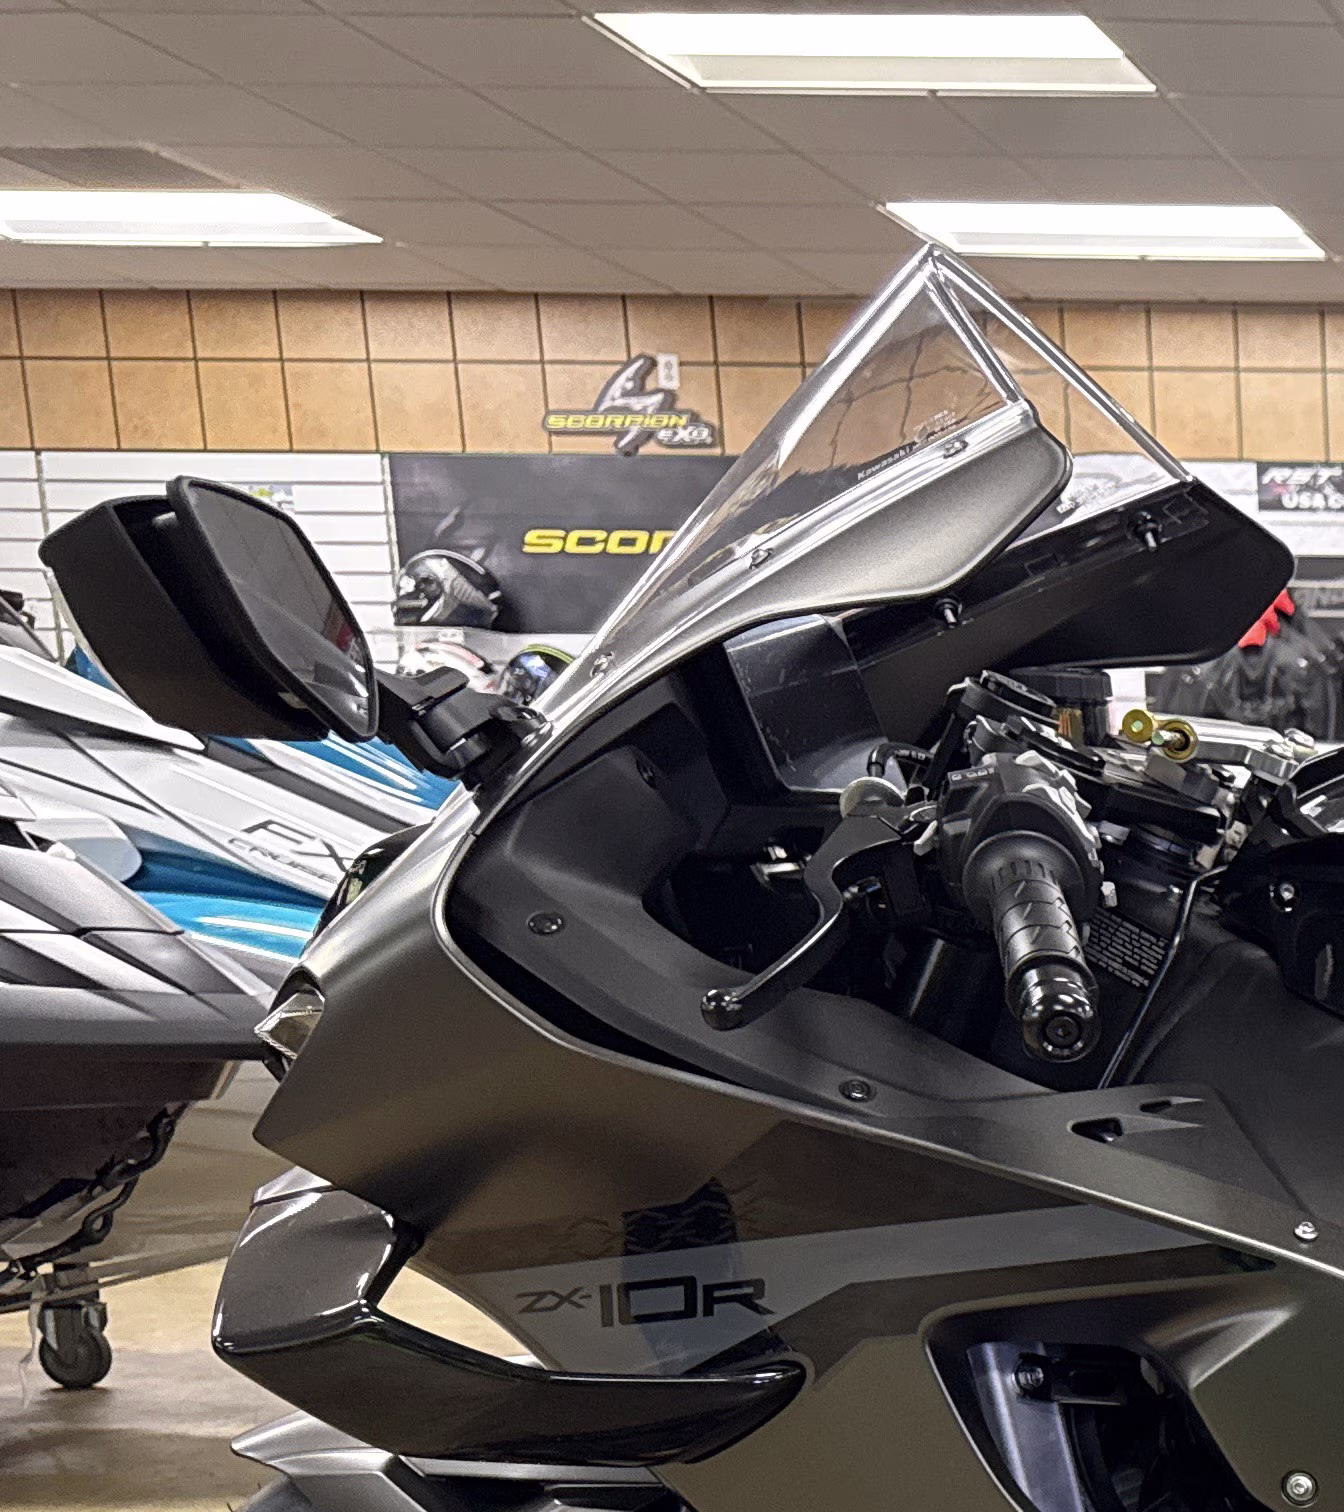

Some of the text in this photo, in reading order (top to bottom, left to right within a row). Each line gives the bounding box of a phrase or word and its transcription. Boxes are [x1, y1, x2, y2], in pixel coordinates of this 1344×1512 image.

[547, 413, 690, 430] SCORPION
[857, 444, 911, 481] Kawasaki
[1281, 491, 1325, 511] USA
[241, 819, 354, 873] FX
